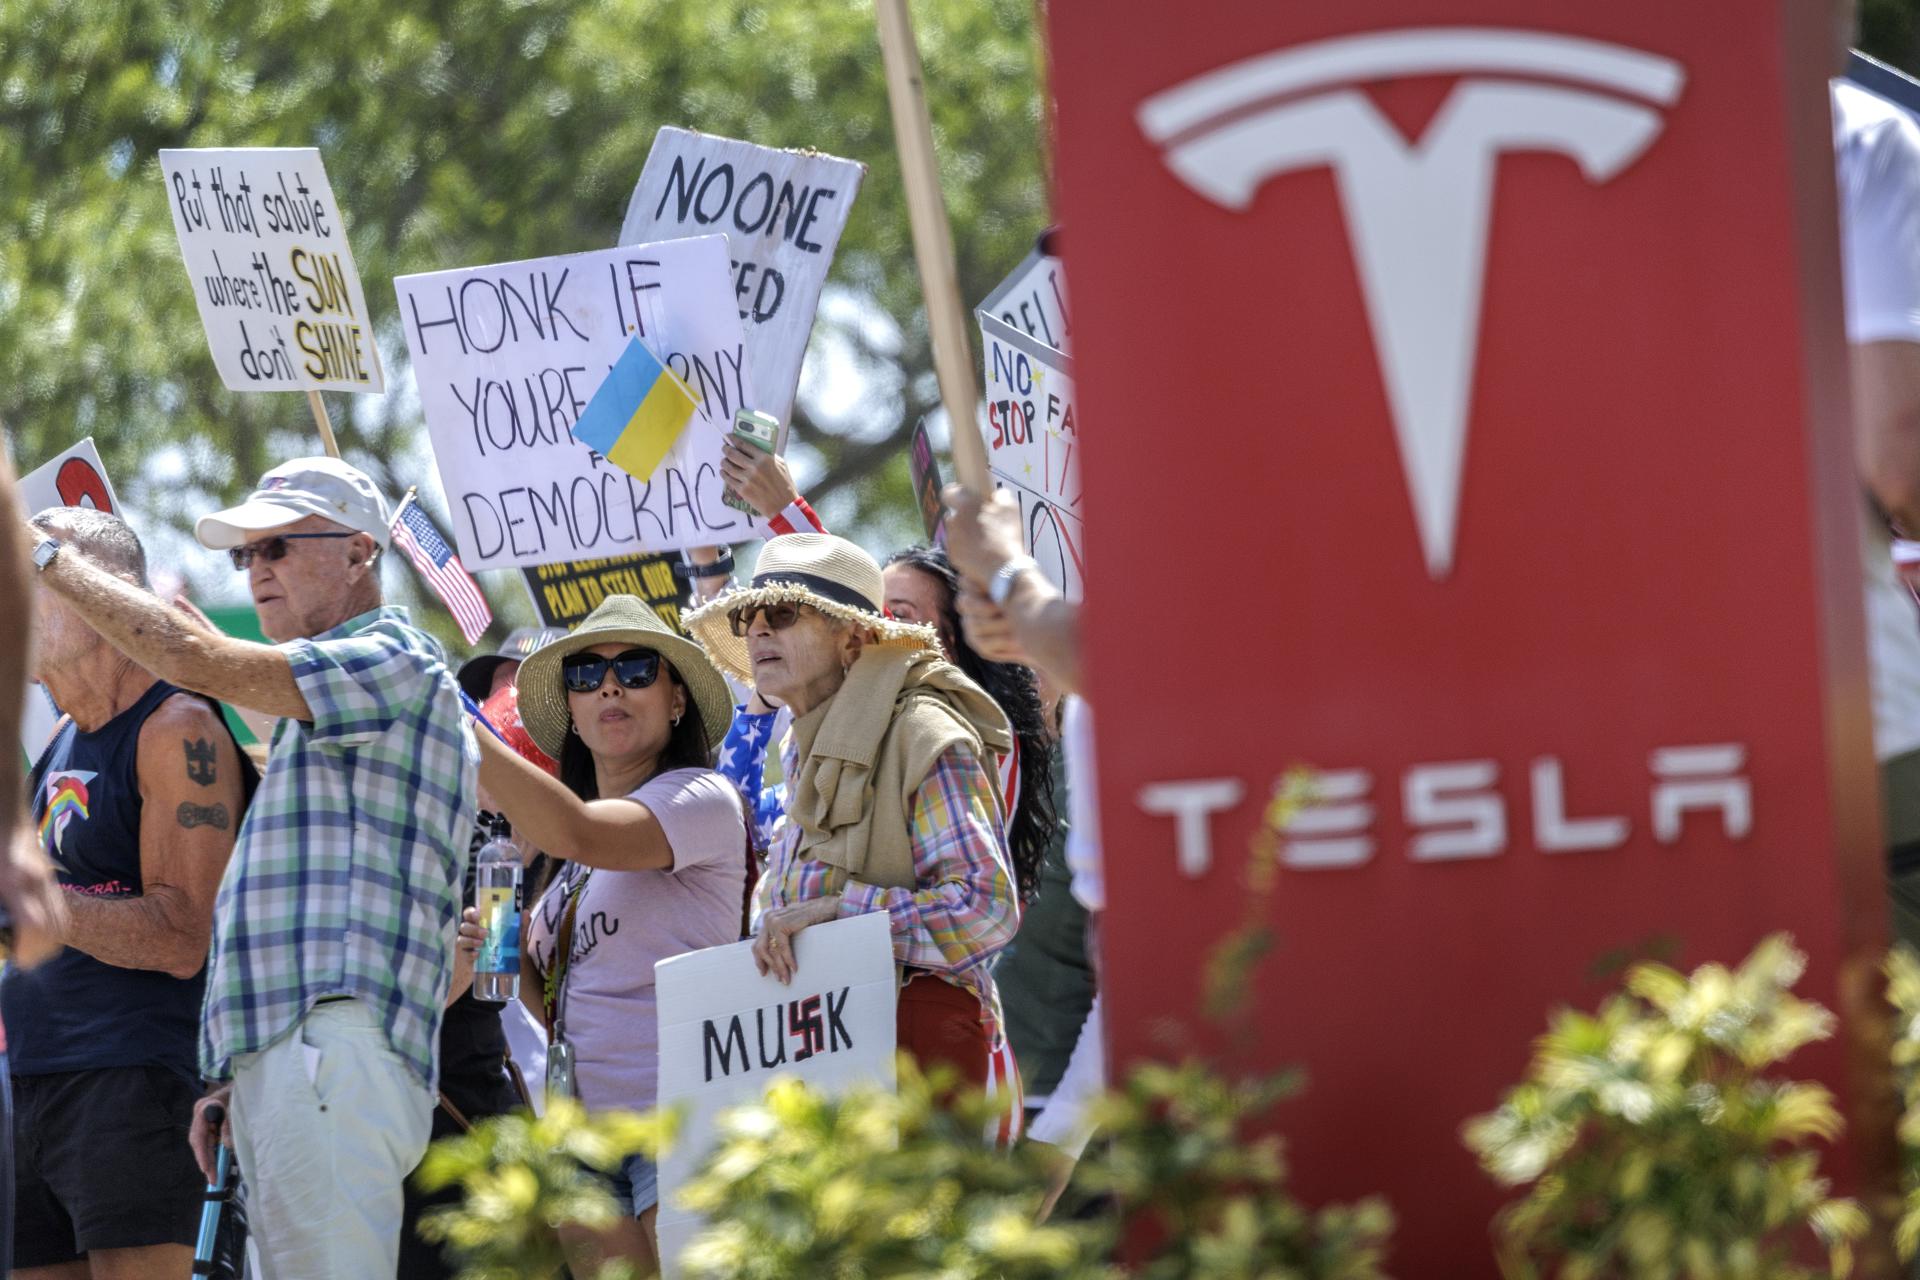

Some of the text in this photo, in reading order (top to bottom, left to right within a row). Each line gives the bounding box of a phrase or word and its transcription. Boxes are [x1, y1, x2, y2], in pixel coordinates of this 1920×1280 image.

[172, 166, 331, 238] Put that salute
[205, 247, 354, 320] where the SUN
[408, 259, 662, 355] HONK IF
[295, 320, 370, 384] SHINE
[993, 341, 1033, 396] NO
[989, 399, 1036, 450] STOP
[462, 462, 754, 560] DEMOCRAC
[544, 582, 587, 619] PLAN
[578, 575, 603, 610] TO
[601, 567, 650, 601] STEAL
[641, 561, 677, 599] OUR
[1138, 744, 1752, 877] TESLA
